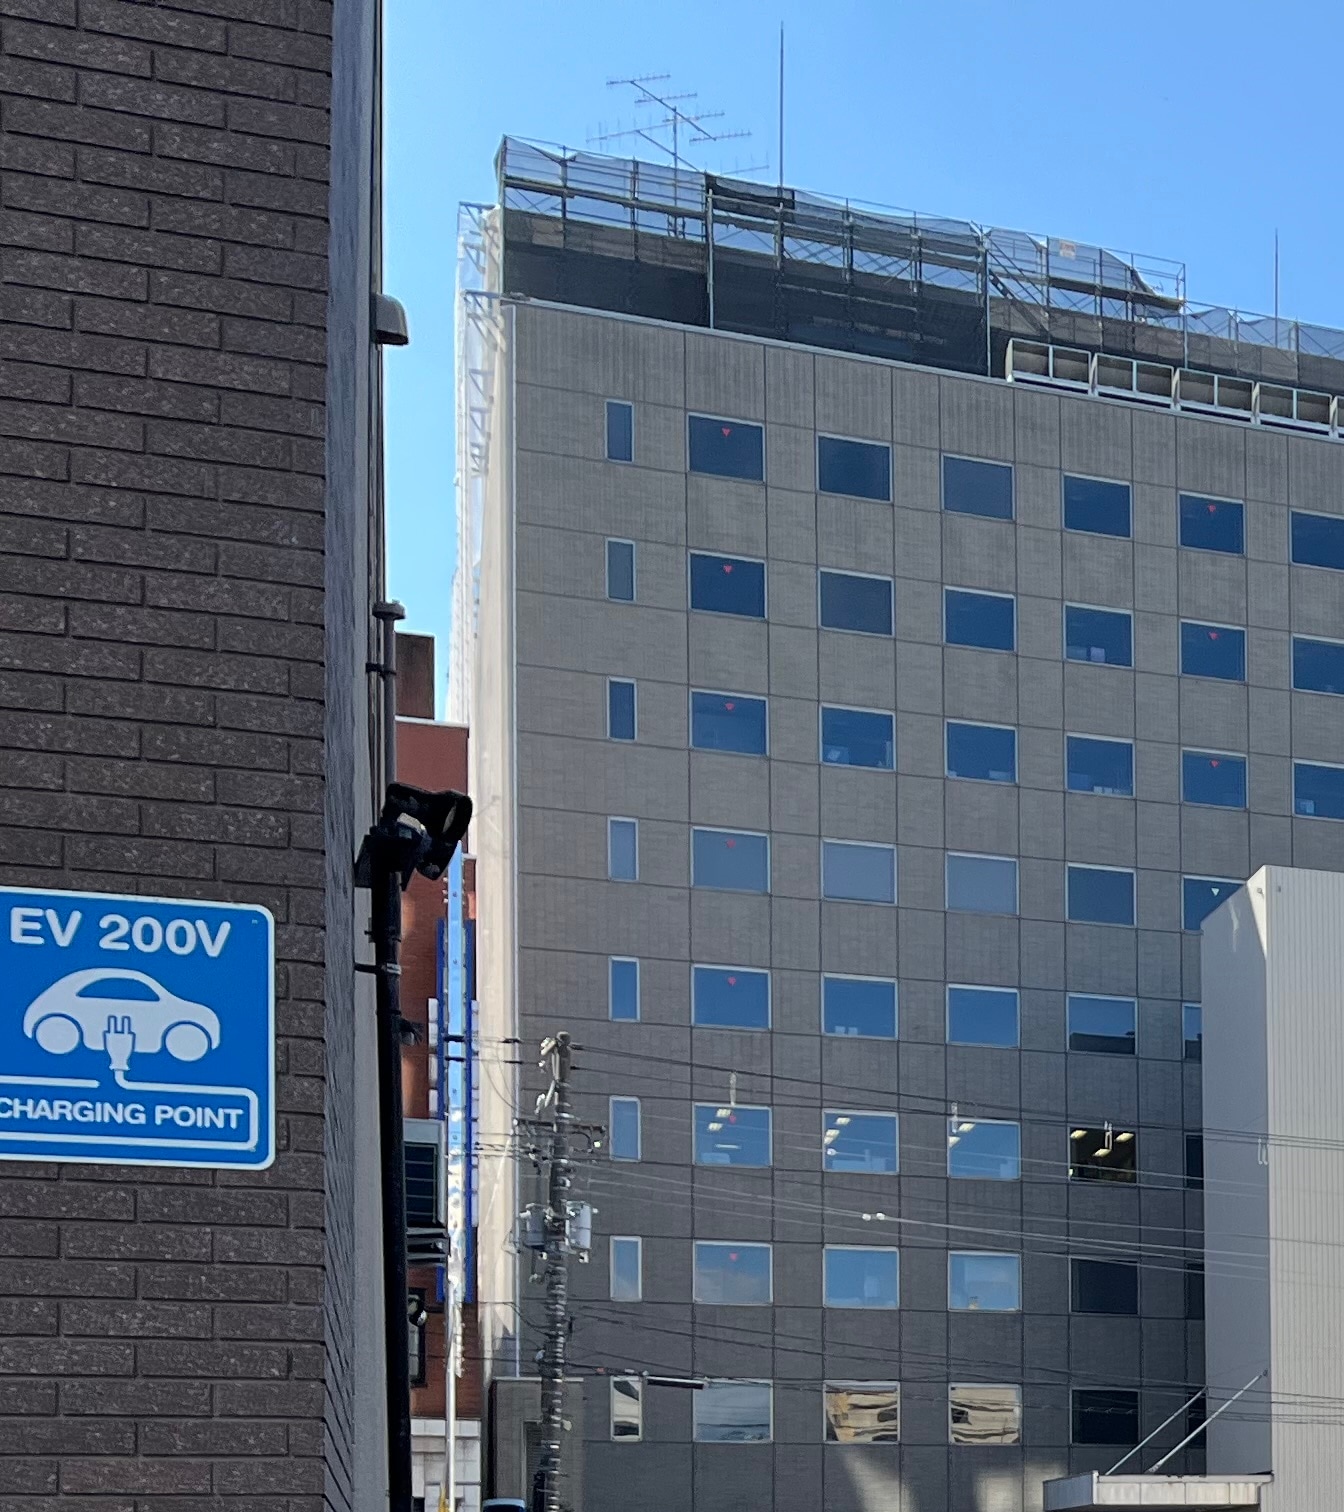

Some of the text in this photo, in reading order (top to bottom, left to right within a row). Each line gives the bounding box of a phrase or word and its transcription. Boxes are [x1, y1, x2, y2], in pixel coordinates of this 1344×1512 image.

[10, 907, 231, 957] EV 200V
[0, 1097, 244, 1129] CHARGING POINT
